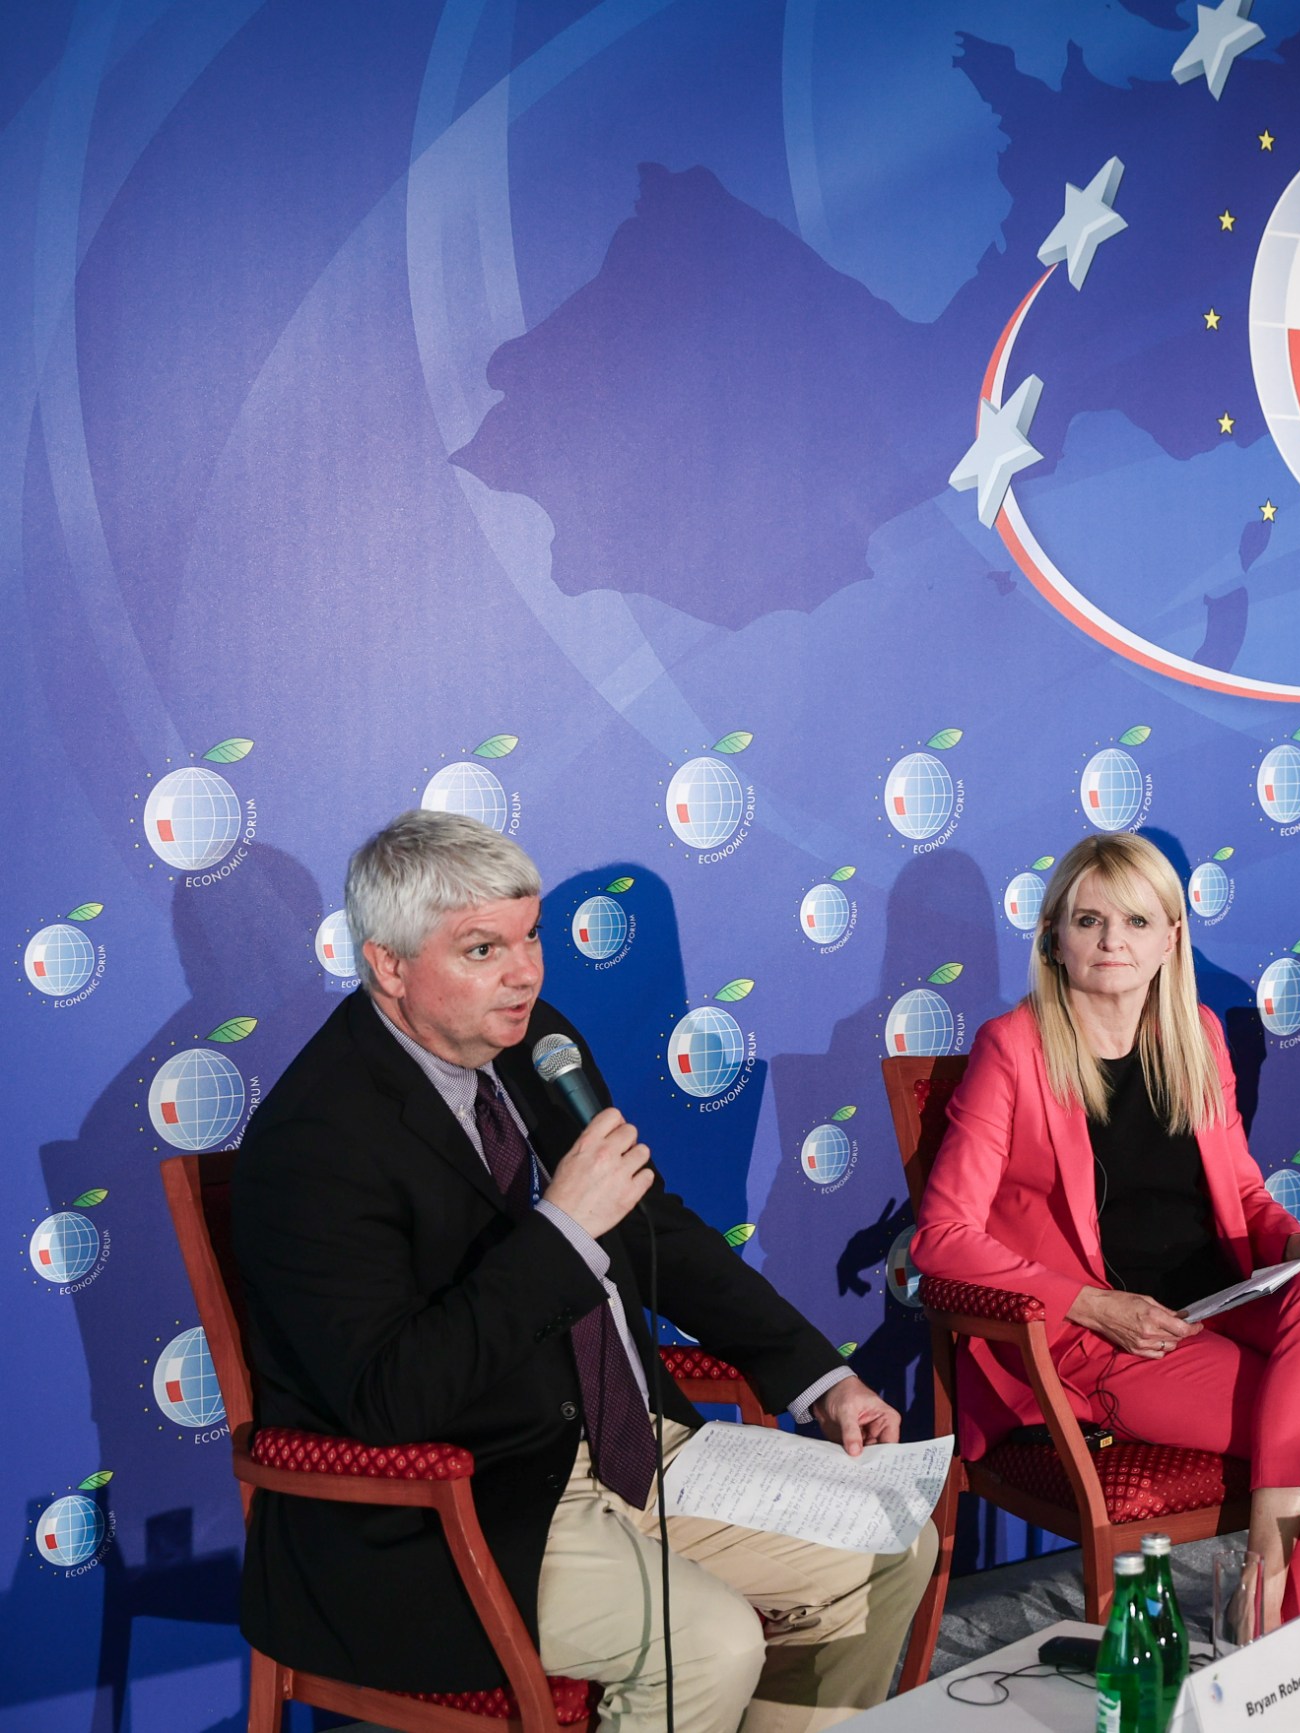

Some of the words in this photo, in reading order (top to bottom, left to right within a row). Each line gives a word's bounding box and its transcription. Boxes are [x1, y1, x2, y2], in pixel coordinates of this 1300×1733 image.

[508, 791, 521, 836] FORUM
[913, 820, 958, 854] ECONOMIC
[953, 779, 965, 819] FORUM
[1142, 773, 1153, 812] FORUM
[185, 847, 248, 888] ECONOMIC
[242, 798, 257, 846] FORUM
[698, 828, 748, 864] ECONOMIC
[743, 785, 756, 827] FORUM
[594, 944, 631, 971] ECONOMIC
[626, 914, 637, 943] FORUM
[820, 930, 853, 954] ECONOMIC
[849, 900, 858, 929] FORUM
[54, 979, 100, 1008] ECONOMIC
[95, 944, 107, 978] FORUM
[954, 1012, 965, 1052] FORUM
[699, 1074, 750, 1113] ECONOMIC
[745, 1031, 757, 1073] FORUM
[821, 1168, 854, 1195] ECONOMIC
[849, 1139, 858, 1168] FORUM
[59, 1263, 105, 1295] ECONOMIC
[100, 1229, 111, 1262] FORUM
[194, 1424, 230, 1445] ECON
[1245, 1692, 1278, 1717] Bryan
